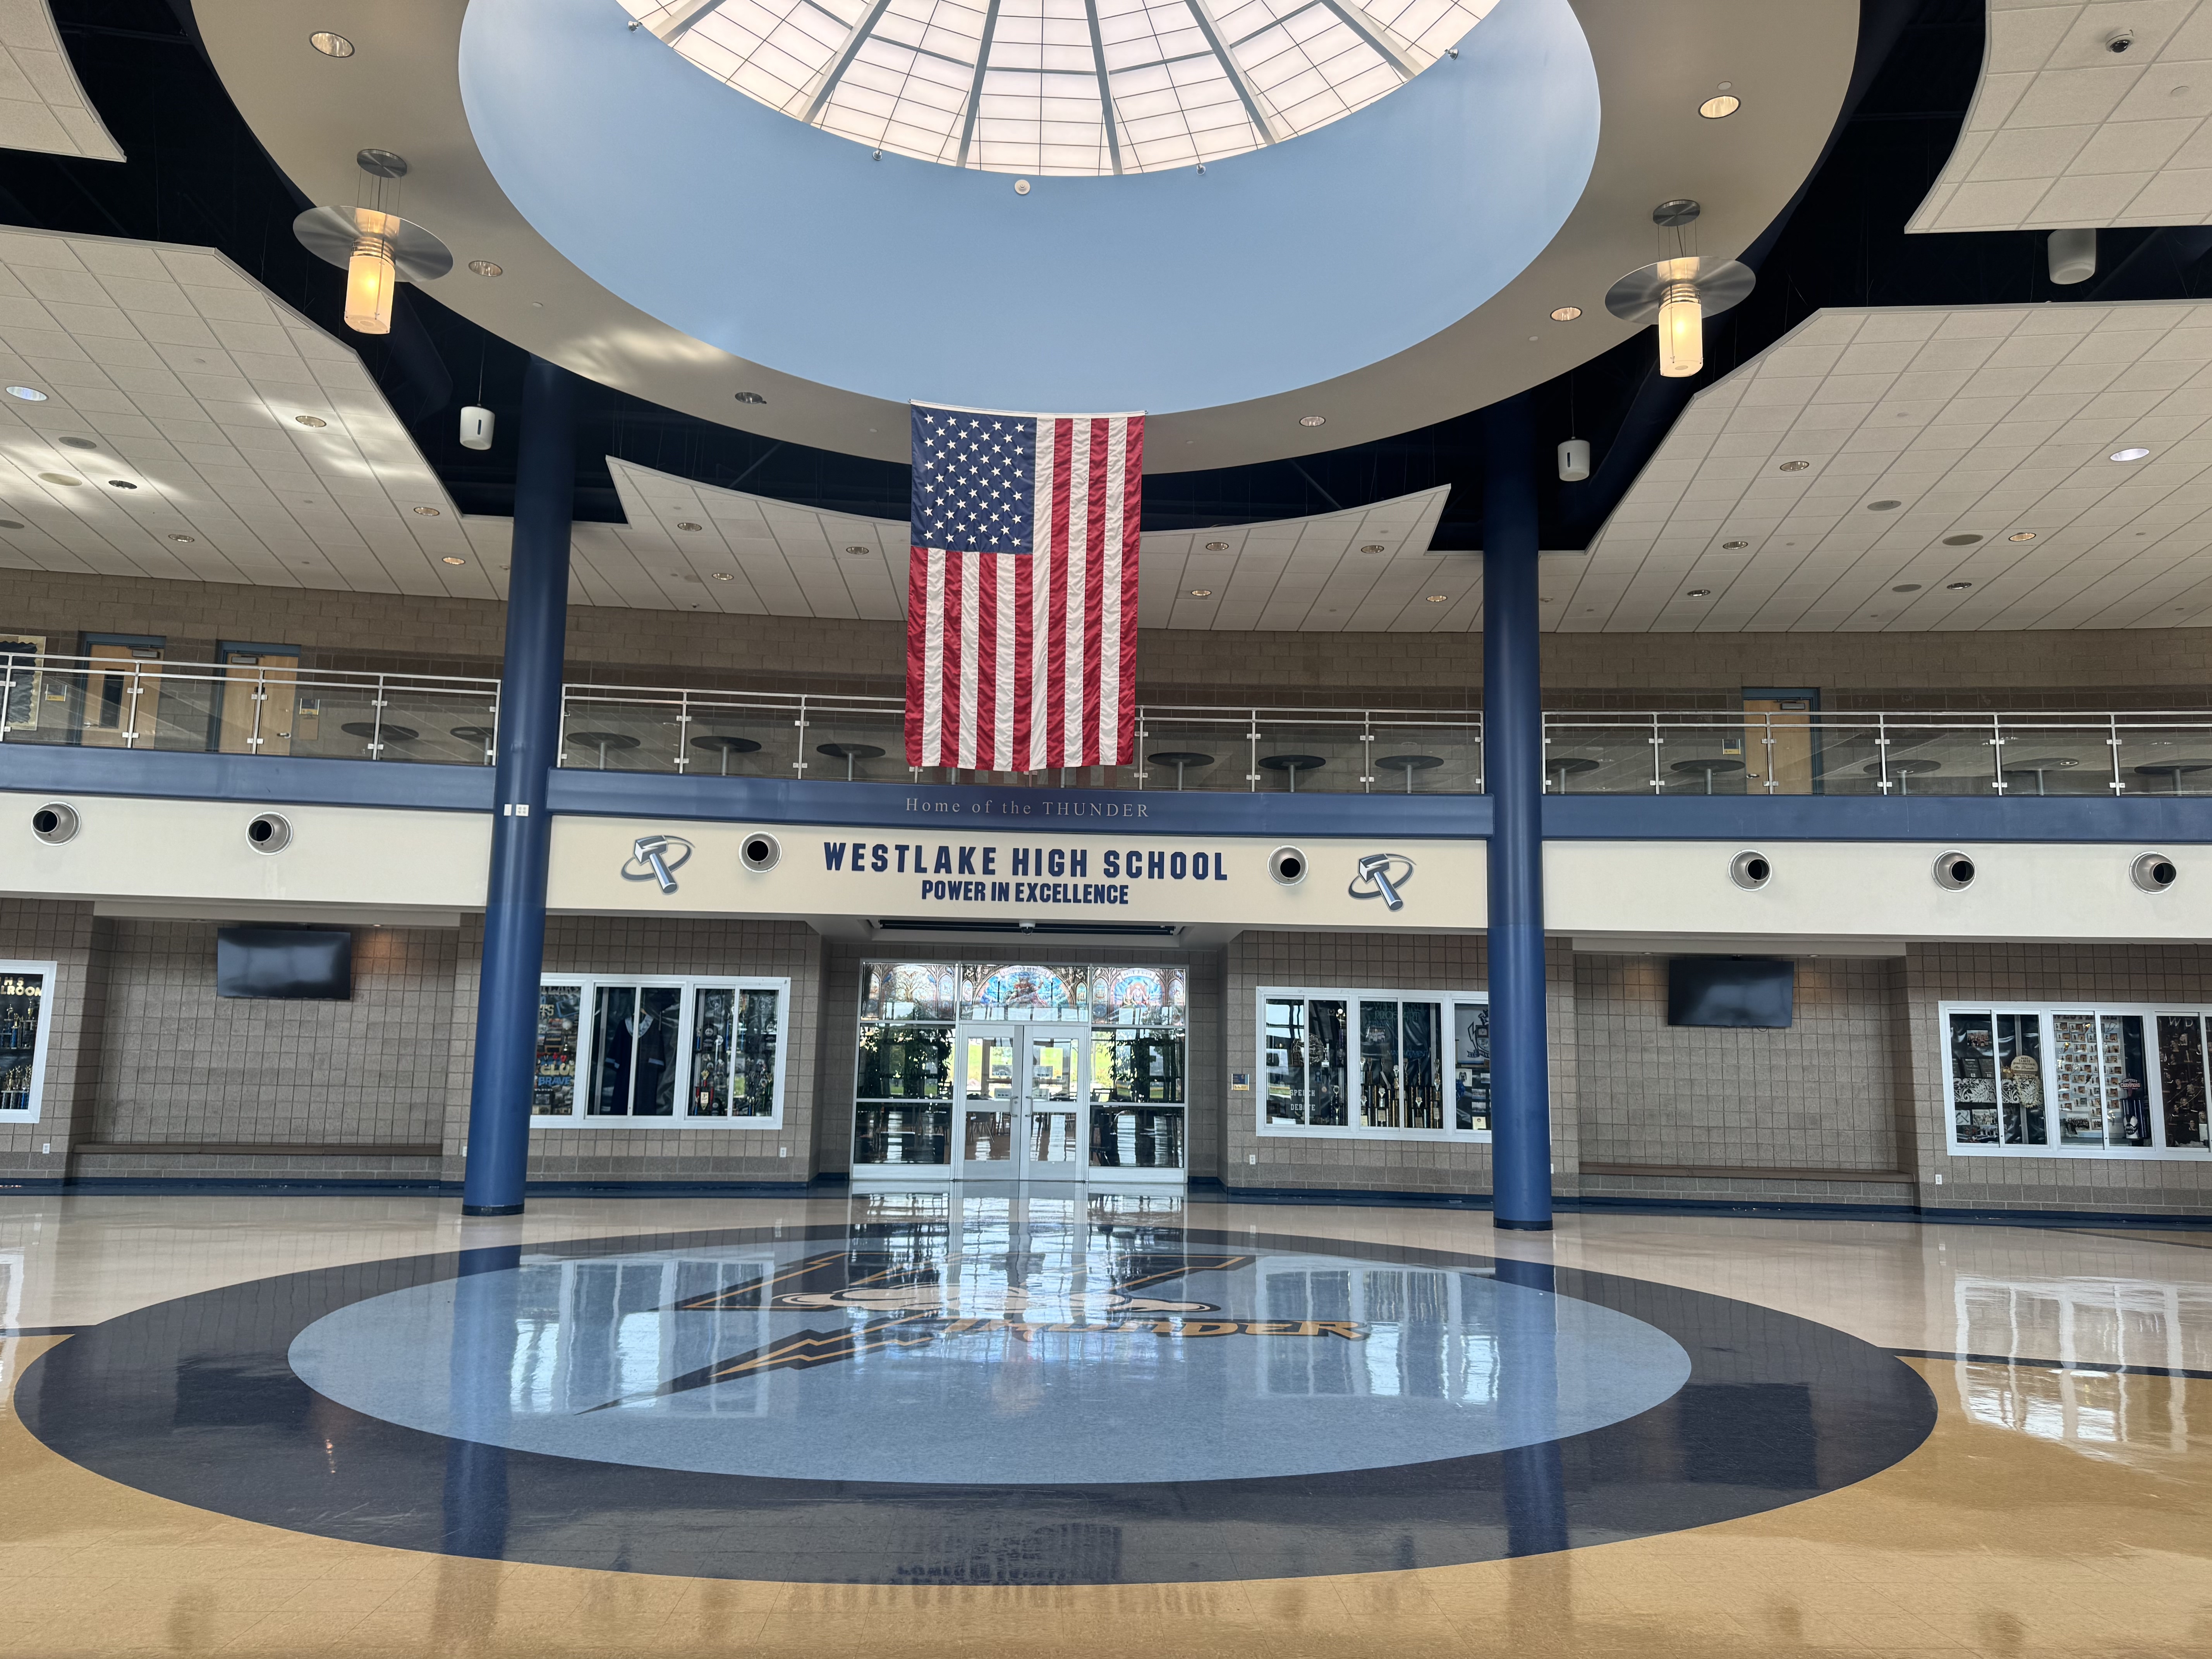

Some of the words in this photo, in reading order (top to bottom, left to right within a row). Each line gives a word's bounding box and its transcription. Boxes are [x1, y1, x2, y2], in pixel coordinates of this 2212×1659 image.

[906, 798, 960, 812] Home
[972, 800, 993, 814] of
[1002, 800, 1031, 814] the
[1042, 802, 1149, 817] THUNDER
[823, 842, 996, 875] WESTLAKE
[1012, 848, 1087, 877] HIGH
[1103, 850, 1228, 881] SCHOOL
[921, 879, 986, 902] POWER
[991, 881, 1010, 902] IN
[1015, 882, 1129, 905] EXCELLENCE
[538, 1076, 571, 1086] BRAVE
